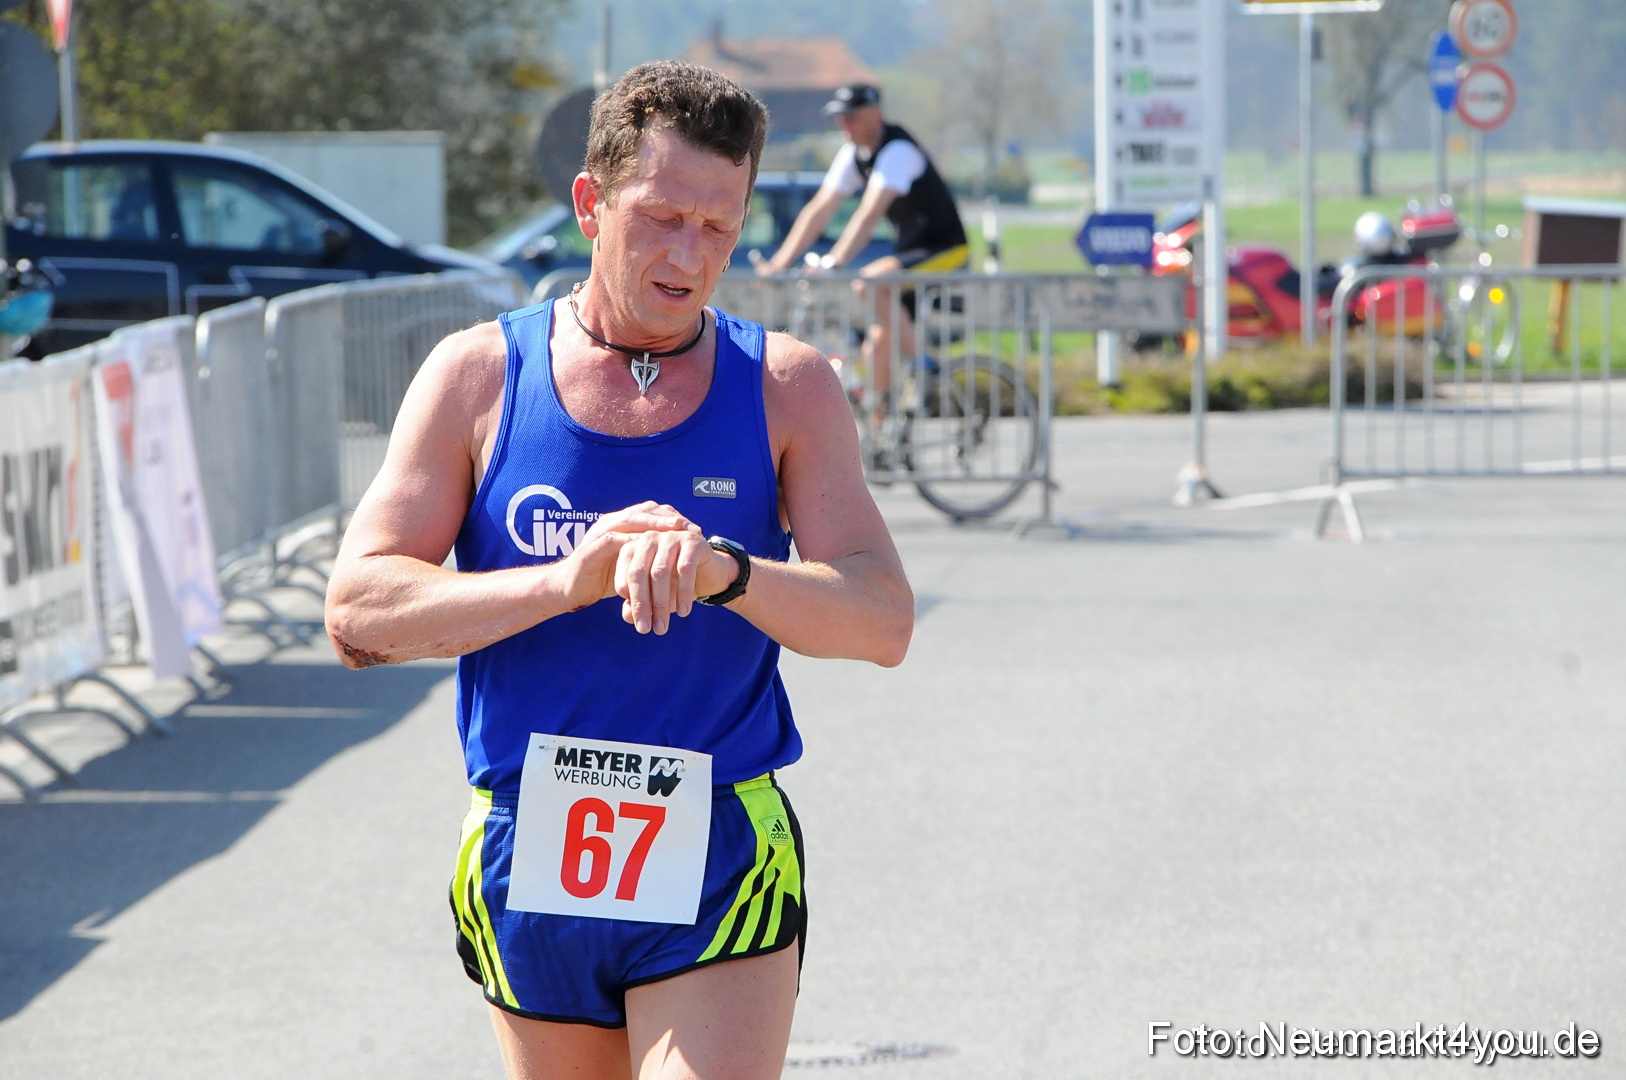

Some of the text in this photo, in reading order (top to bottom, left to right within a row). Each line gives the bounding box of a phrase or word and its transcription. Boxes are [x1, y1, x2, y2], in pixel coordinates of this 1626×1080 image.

[710, 480, 736, 492] RONO
[554, 746, 643, 774] MEYER
[554, 767, 642, 790] WERBUNG
[770, 831, 789, 840] adidas
[560, 797, 667, 902] 67
